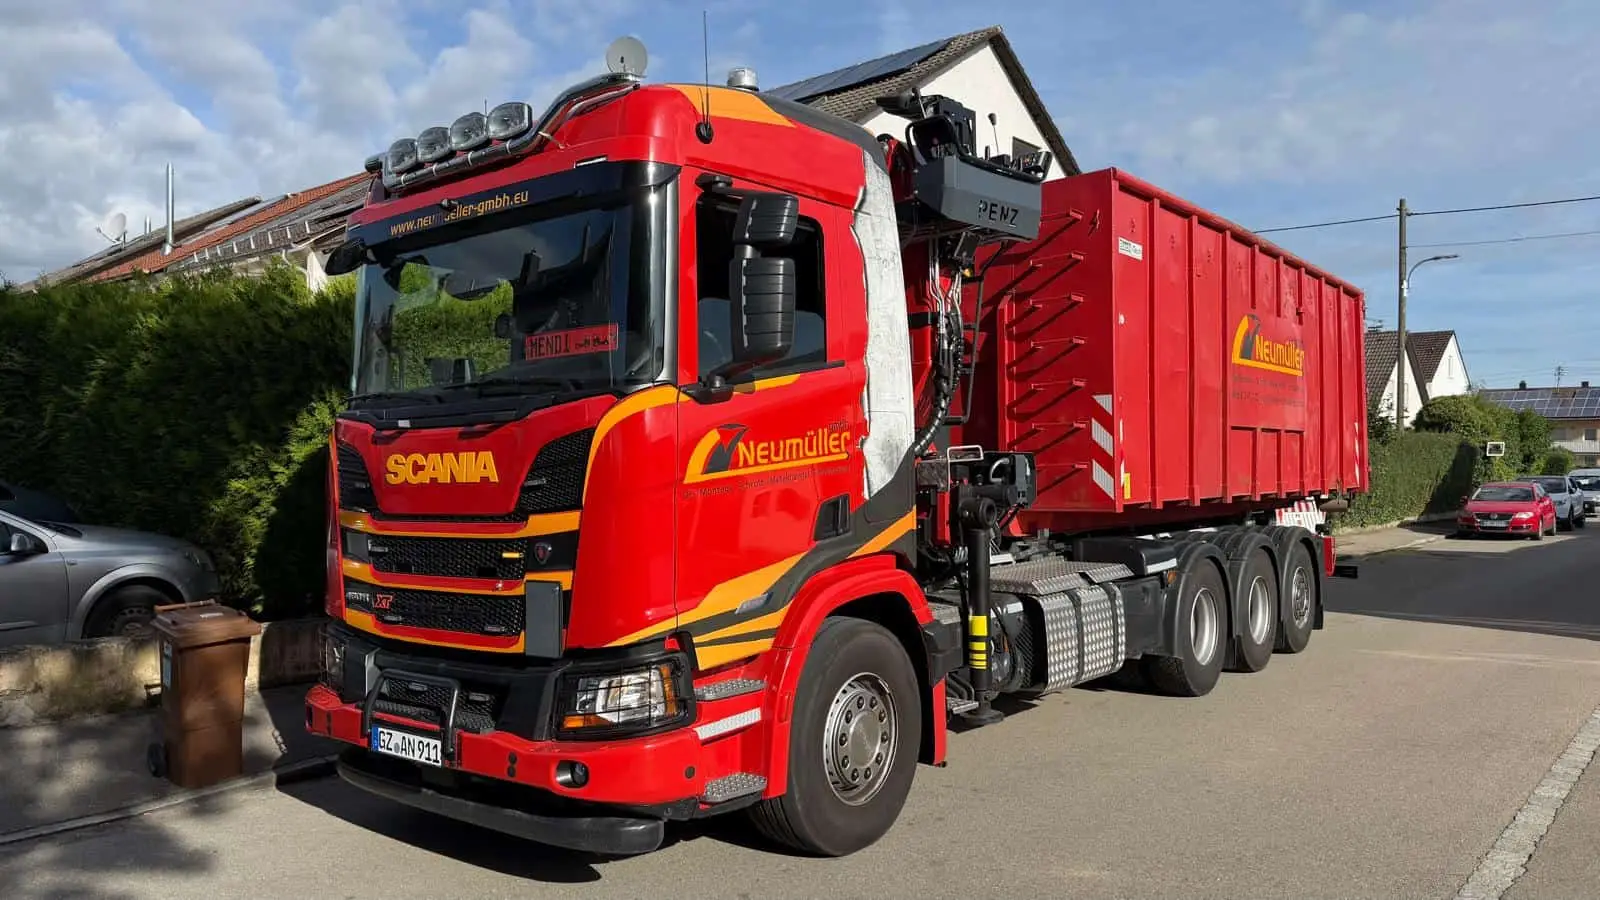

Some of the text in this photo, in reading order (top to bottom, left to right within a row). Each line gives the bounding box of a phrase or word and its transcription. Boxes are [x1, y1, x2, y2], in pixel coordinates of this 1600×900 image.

[978, 199, 1019, 226] PENZ
[738, 428, 851, 468] Neumüller
[385, 450, 499, 485] SCANIA
[379, 731, 440, 764] GZ AN 911
